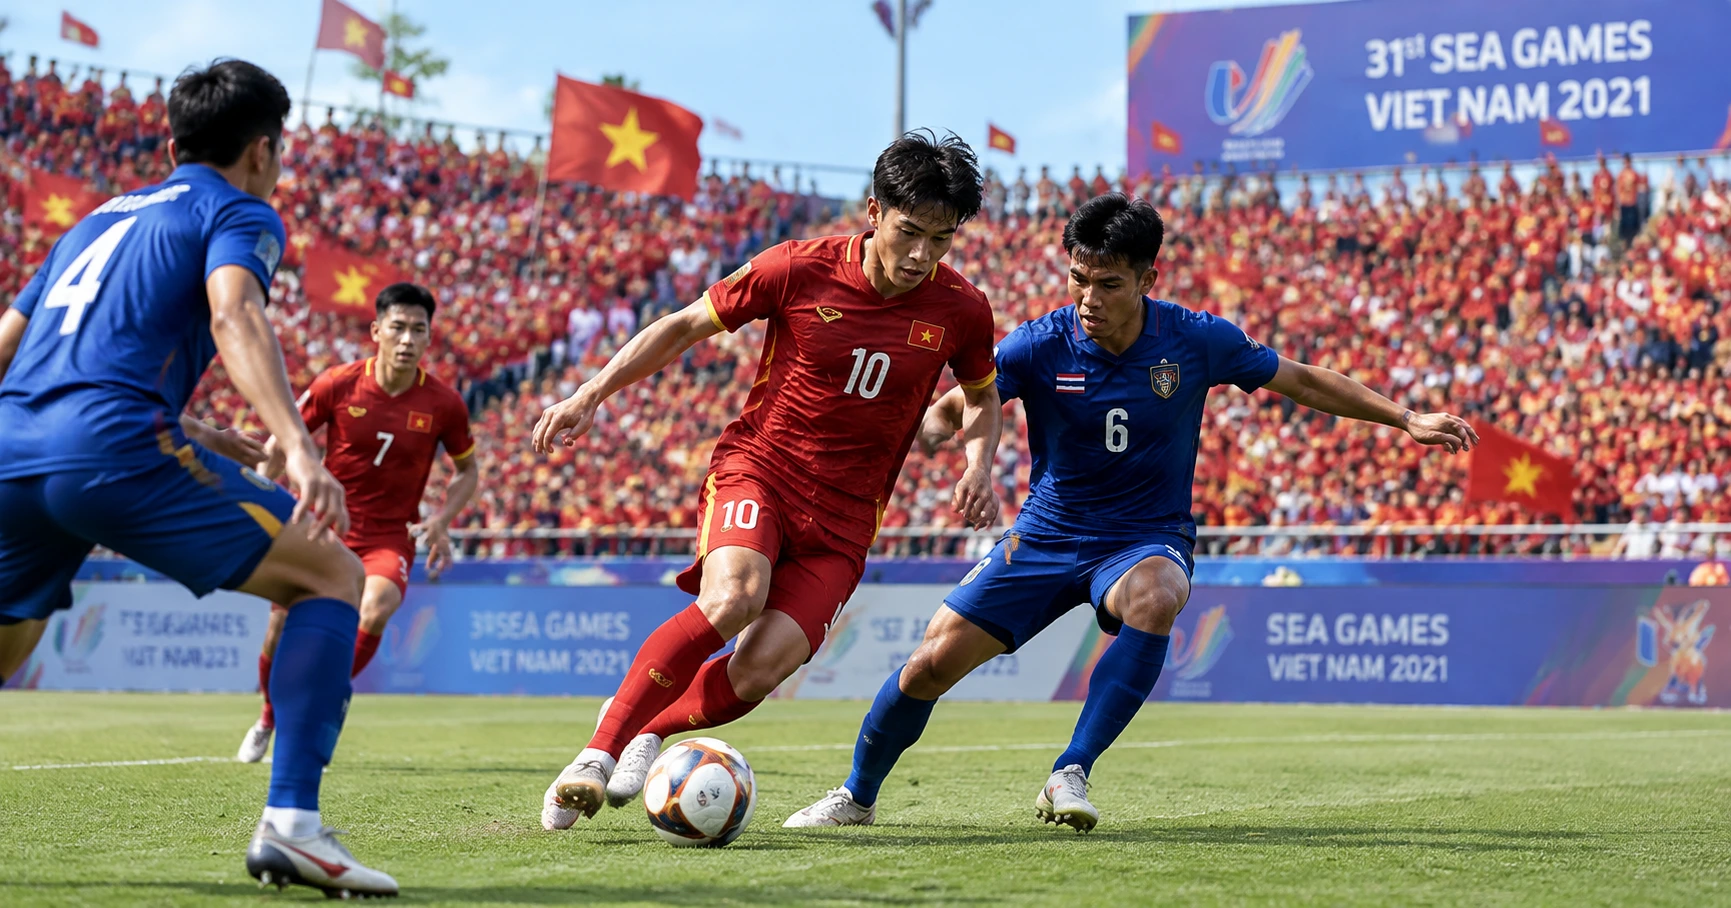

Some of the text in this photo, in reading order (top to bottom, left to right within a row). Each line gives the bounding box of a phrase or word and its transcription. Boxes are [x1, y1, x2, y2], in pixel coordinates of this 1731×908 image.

[1430, 31, 1507, 74] SEA
[1511, 19, 1653, 69] GAMES
[1365, 75, 1651, 131] VIET NAM 2021
[44, 215, 138, 336] 4
[843, 347, 891, 399] 10
[1105, 407, 1129, 453] 6
[373, 431, 395, 467] 7
[721, 499, 760, 530] 10
[545, 611, 632, 641] GAMES
[1266, 613, 1450, 646] SEA GAMES
[516, 648, 571, 674] NAM
[574, 649, 630, 675] 2021
[1267, 654, 1449, 683] VIET NAM 2021
